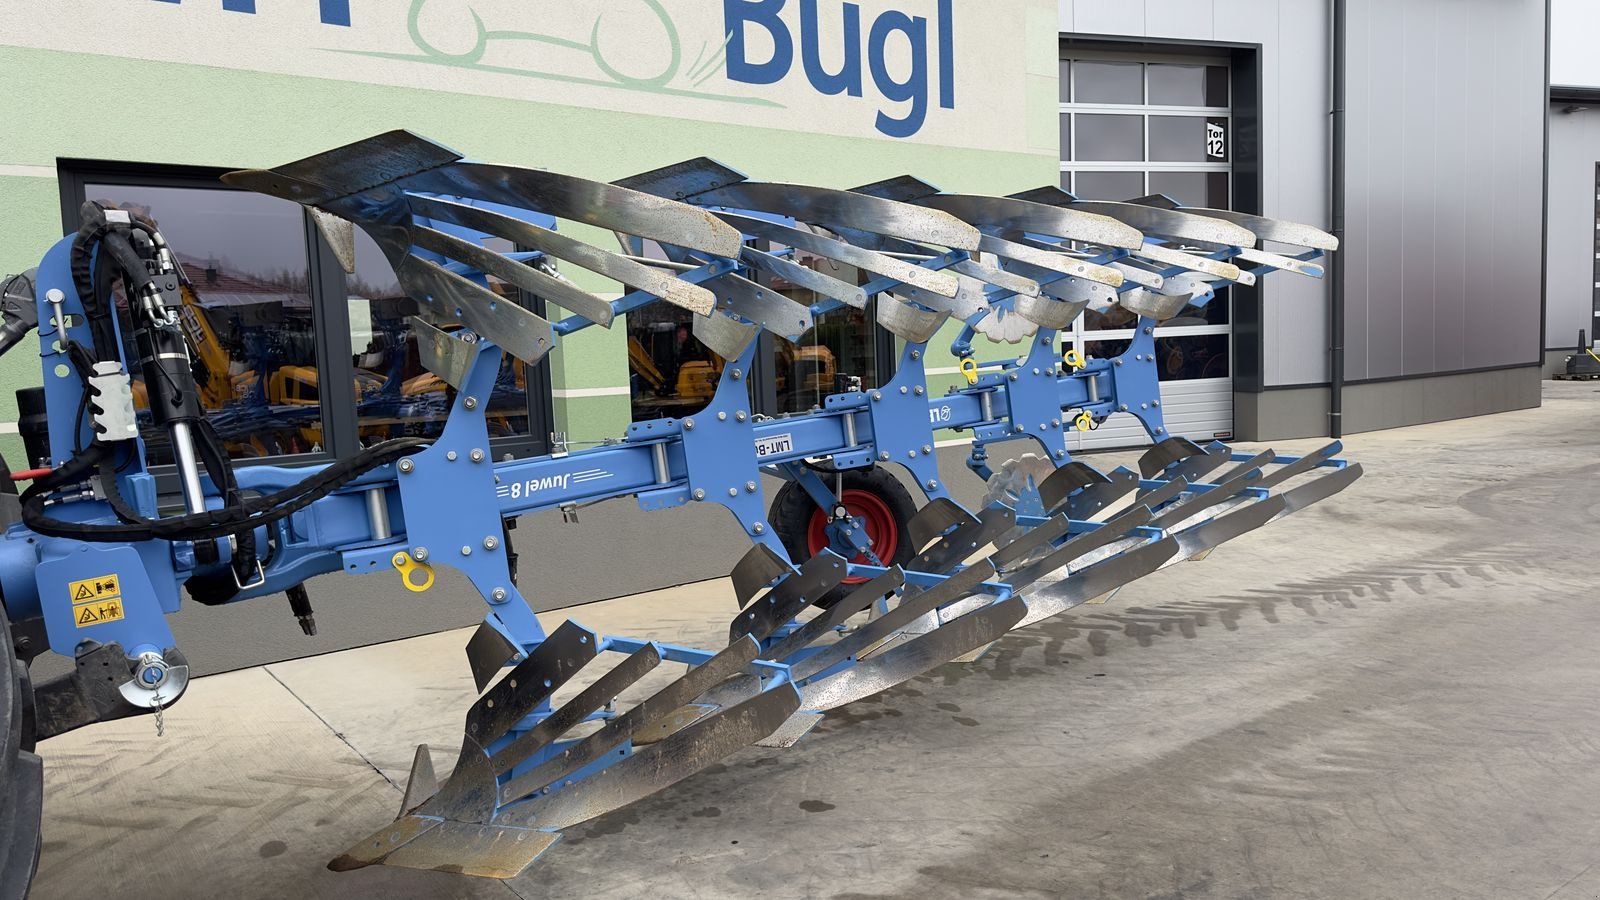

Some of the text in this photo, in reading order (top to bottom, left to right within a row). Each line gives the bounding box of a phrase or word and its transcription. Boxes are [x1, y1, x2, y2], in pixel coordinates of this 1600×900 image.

[1207, 129, 1223, 138] Tor
[1207, 140, 1223, 154] 12
[511, 473, 571, 499] Juwel 8
